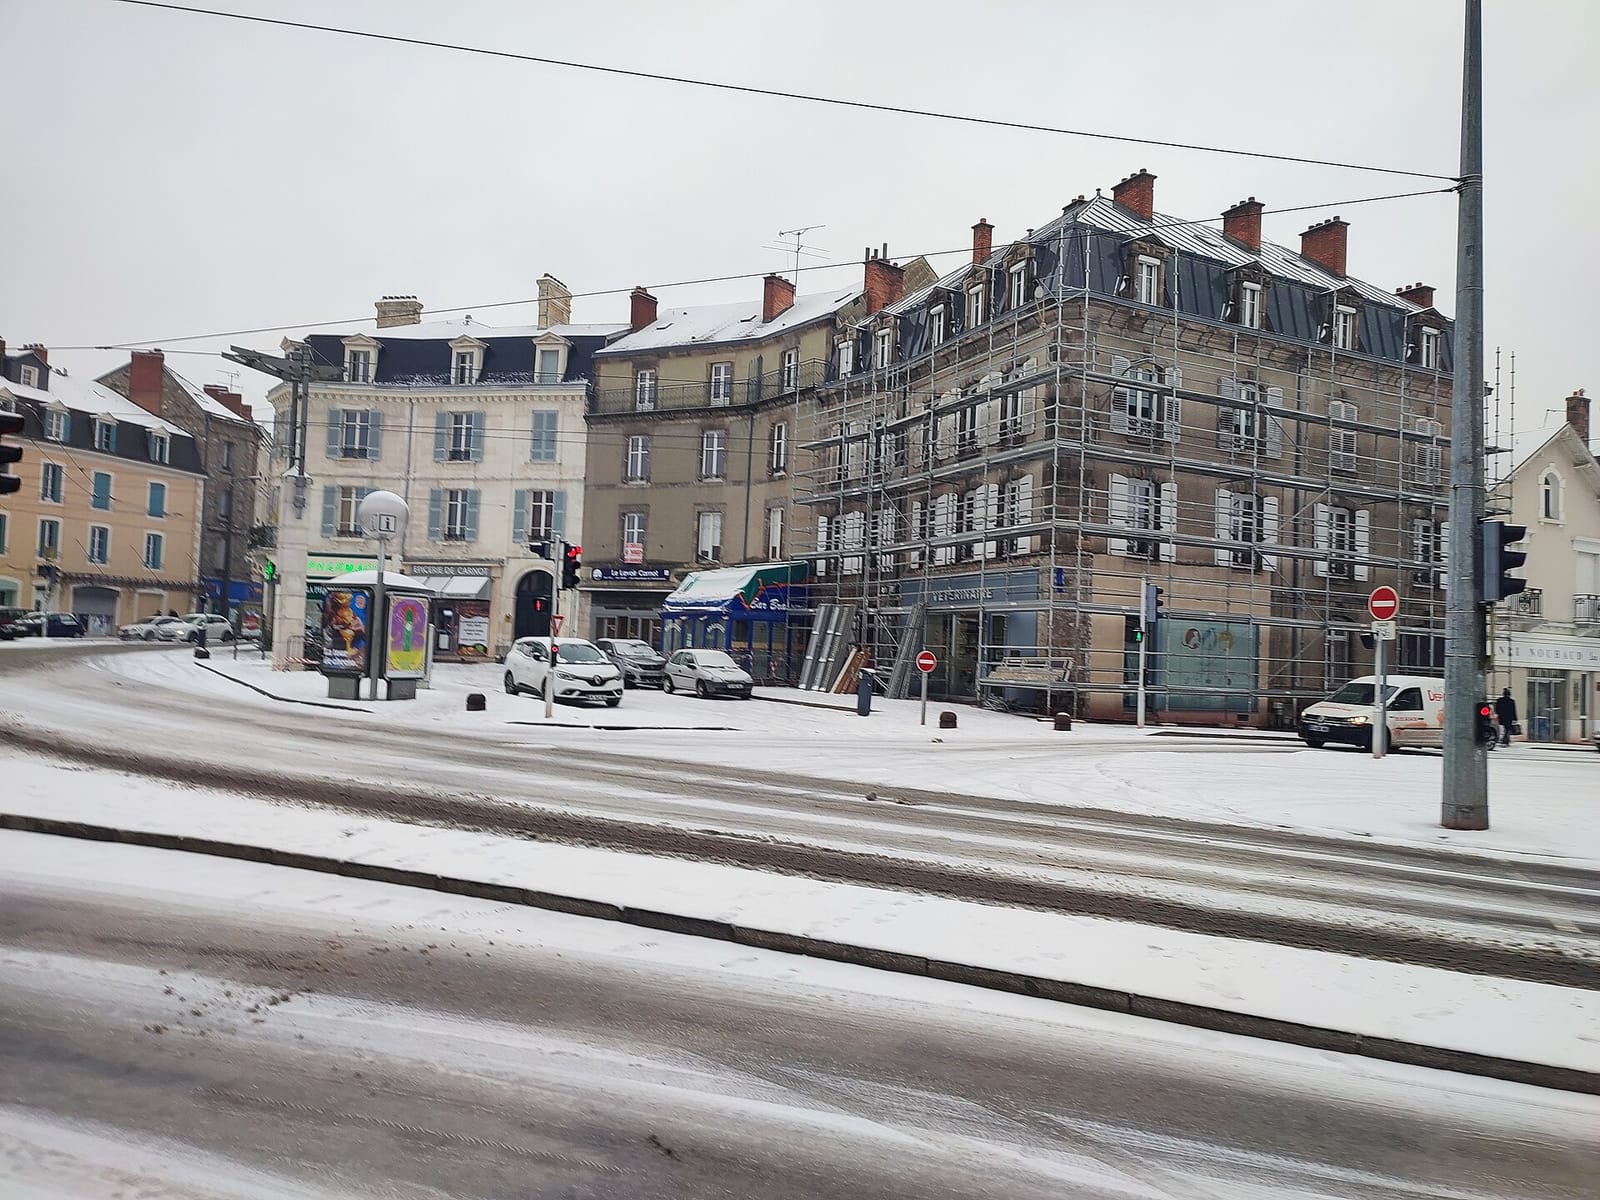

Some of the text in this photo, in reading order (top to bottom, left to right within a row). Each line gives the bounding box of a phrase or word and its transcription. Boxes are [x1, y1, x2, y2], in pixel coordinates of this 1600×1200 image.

[444, 567, 455, 575] DE
[457, 567, 490, 576] CARNOT
[611, 569, 619, 577] Le
[638, 569, 660, 577] Carnot
